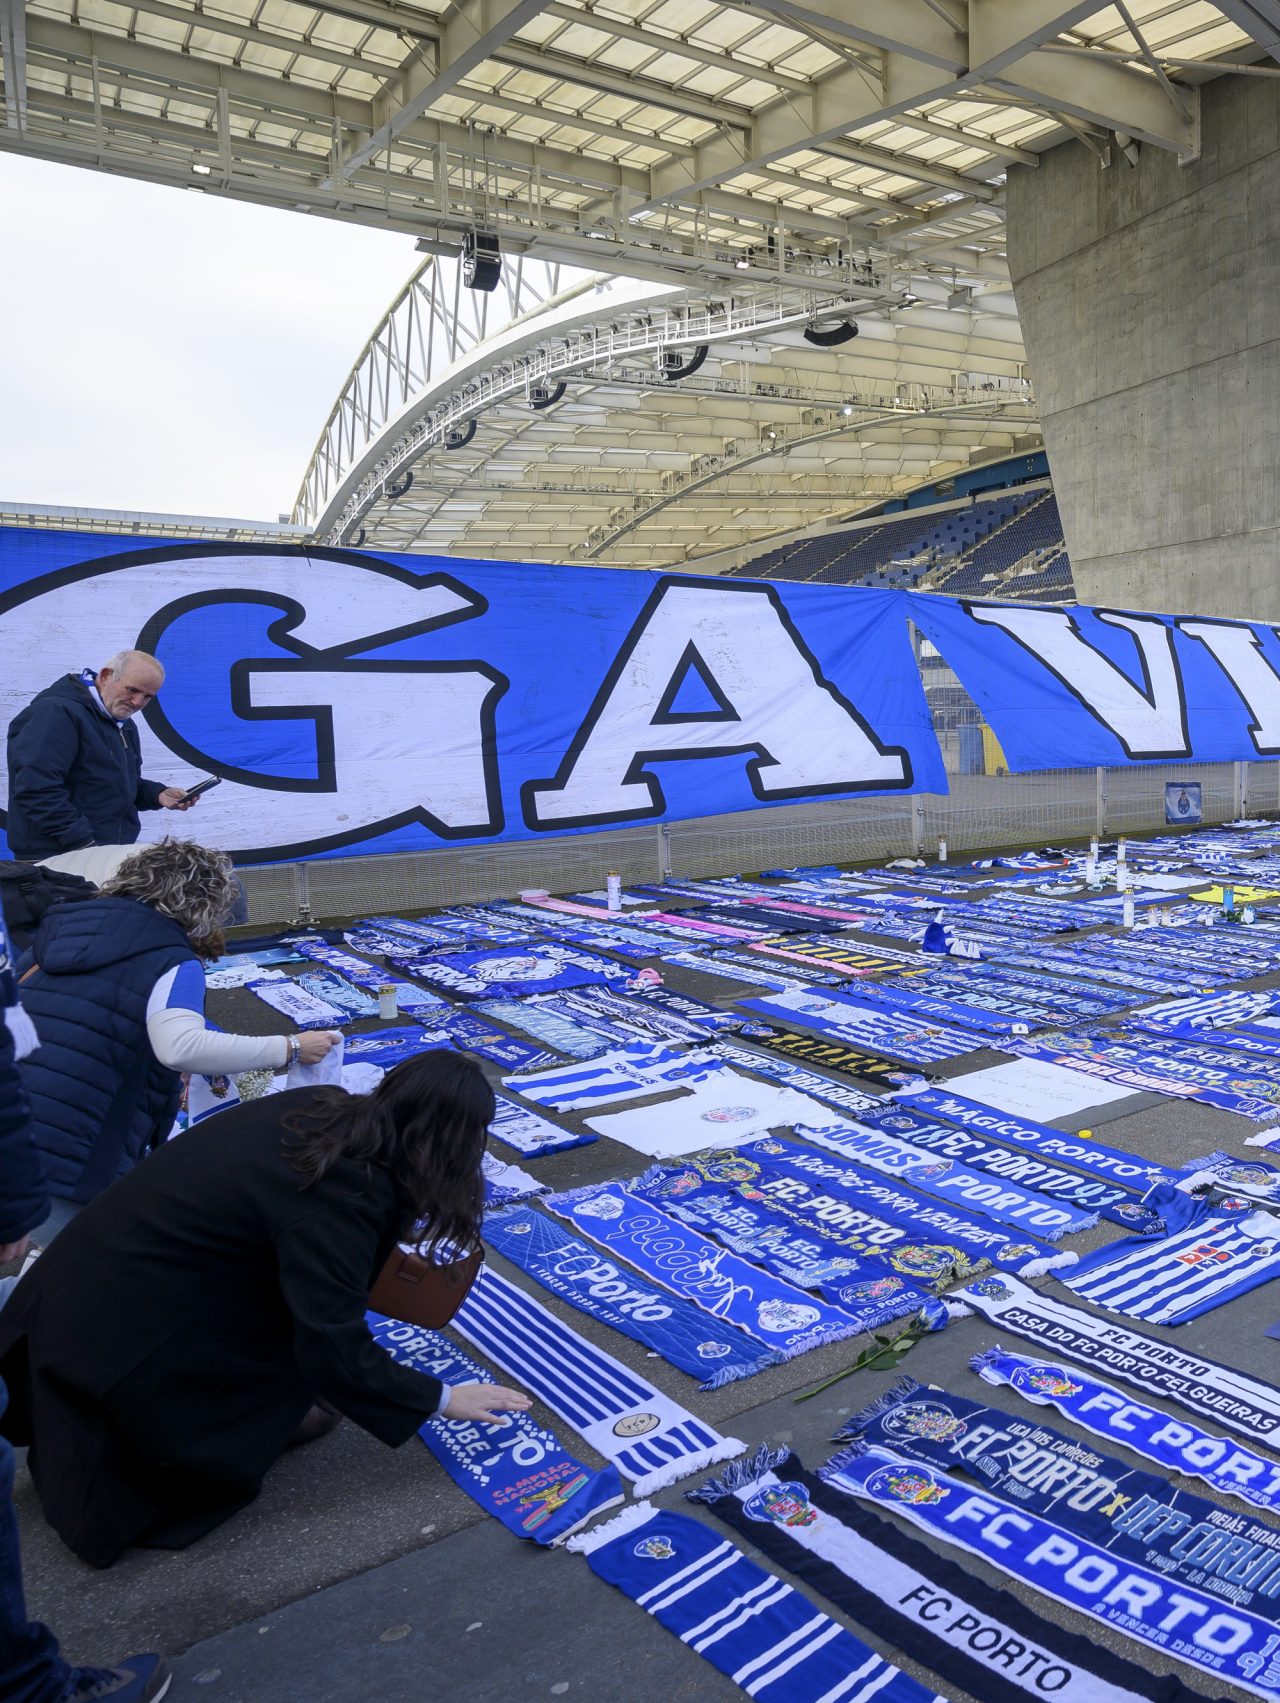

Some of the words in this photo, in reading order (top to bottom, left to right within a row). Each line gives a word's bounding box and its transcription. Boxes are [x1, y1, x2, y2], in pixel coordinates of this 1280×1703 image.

[661, 995, 712, 1016] PORTO
[1140, 1054, 1230, 1080] PORTO
[786, 1070, 881, 1111] DRAGÕES
[812, 1123, 922, 1172] SOMOS
[903, 1124, 956, 1144] 18
[927, 1131, 986, 1157] FC
[934, 1101, 1041, 1141] MÁGICO
[1037, 1138, 1143, 1176] PORTO
[966, 1149, 1085, 1190] PORTO
[759, 1176, 811, 1202] F.C.
[798, 1195, 906, 1244] PORTO
[936, 1173, 1073, 1227] PORTO
[1054, 1182, 1128, 1207] 93
[703, 1208, 755, 1236] PORTO
[908, 1207, 1011, 1249] VENCER
[761, 1240, 820, 1270] PORTO
[573, 1262, 674, 1322] Porto
[877, 1291, 919, 1310] PORTO
[375, 1318, 455, 1375] FORÇA
[1098, 1328, 1134, 1347] FC
[1130, 1341, 1212, 1379] PORTO
[1003, 1309, 1051, 1334] CASA
[1053, 1325, 1076, 1343] DO
[1070, 1335, 1100, 1355] FC
[1095, 1346, 1156, 1379] PORTO
[1154, 1369, 1279, 1432] FELGUEIRAS
[1077, 1393, 1154, 1433] FC
[1006, 1421, 1031, 1441] LIGA
[1029, 1427, 1054, 1447] DOS
[1048, 1439, 1105, 1469] CAMPEÕES
[491, 1461, 573, 1499] CAMPEÃO
[494, 1464, 582, 1507] NACIONAL
[949, 1424, 1012, 1464] FC
[996, 1438, 1118, 1514] PORTO
[1110, 1493, 1192, 1546] DEP
[1216, 1478, 1273, 1505] VENCER
[1205, 1510, 1248, 1532] MEIAS
[943, 1495, 1035, 1550] FC
[1024, 1533, 1255, 1656] PORTO
[898, 1582, 943, 1623] FC
[949, 1609, 1075, 1694] PORTO
[1106, 1607, 1171, 1644] VENCER
[1170, 1634, 1226, 1670] DESDE
